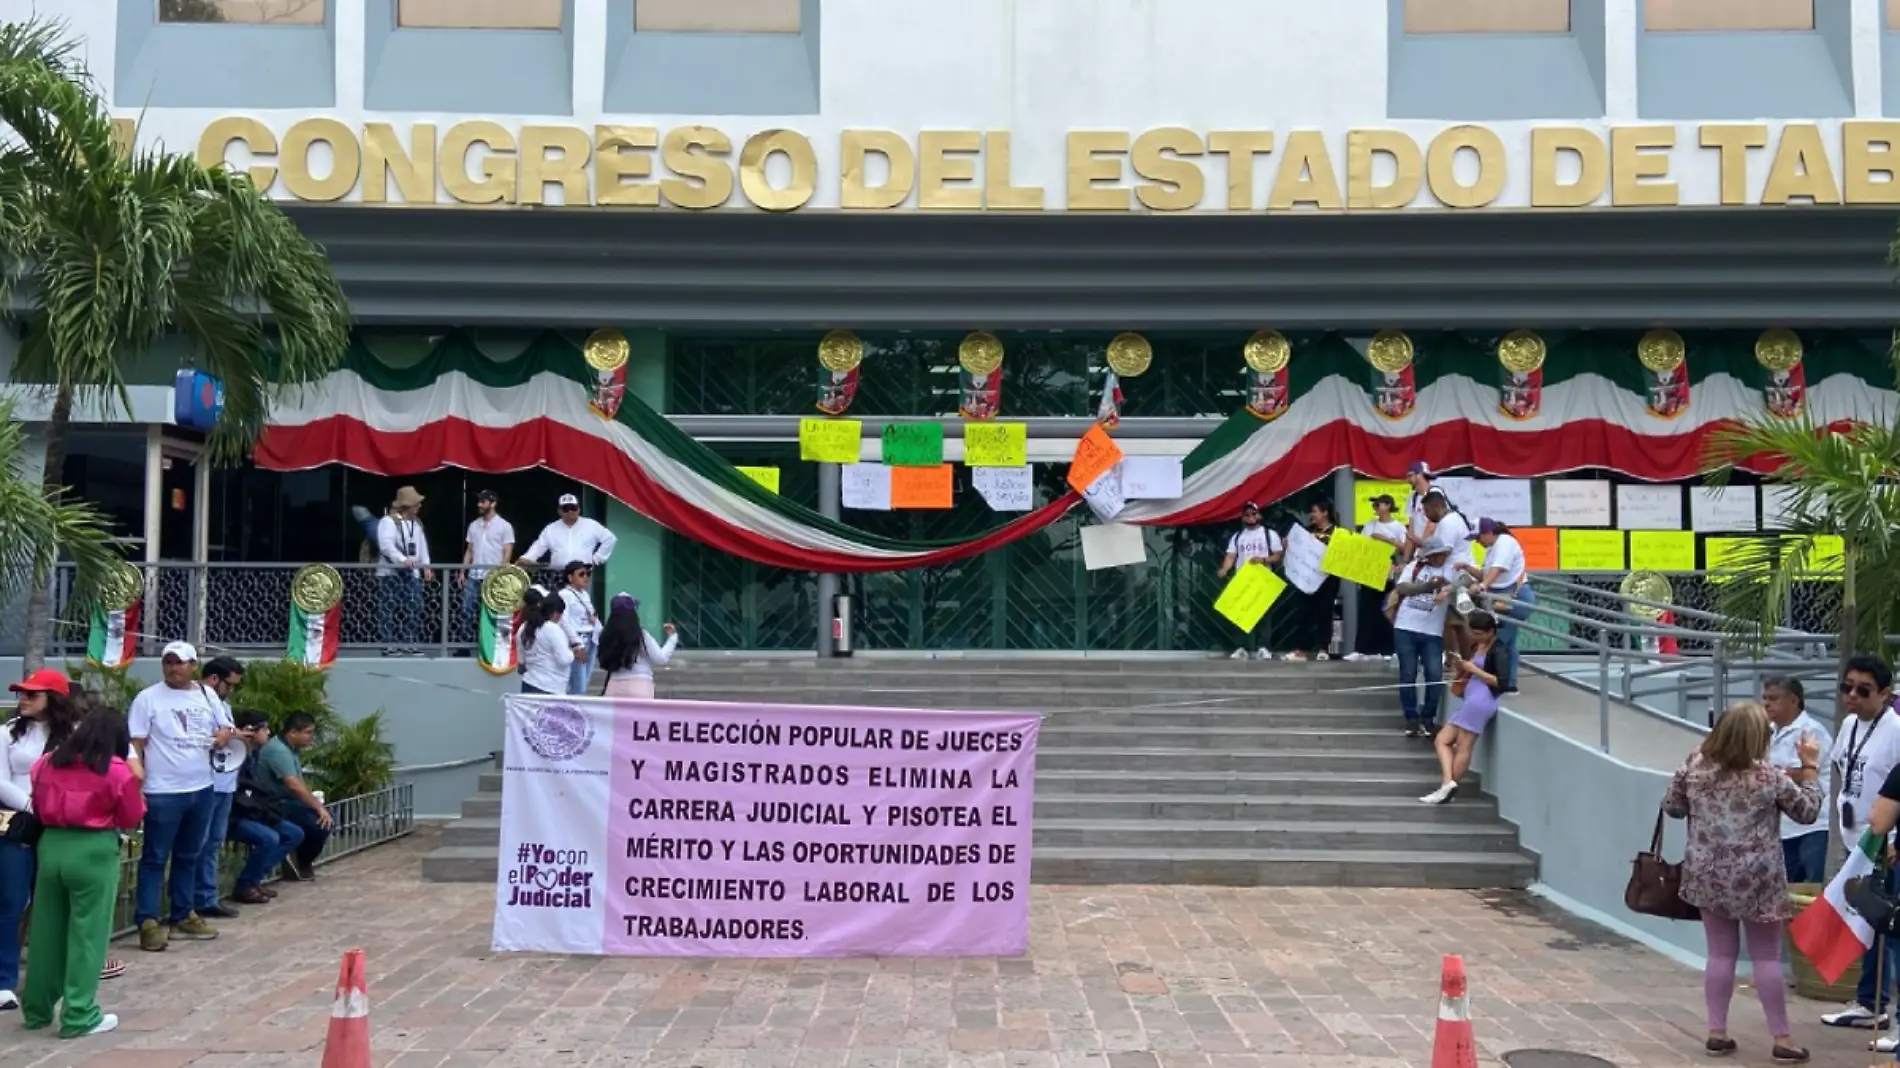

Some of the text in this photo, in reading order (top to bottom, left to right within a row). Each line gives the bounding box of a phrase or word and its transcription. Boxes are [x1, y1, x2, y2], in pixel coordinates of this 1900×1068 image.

[196, 118, 815, 211] CONGRESO
[840, 130, 1043, 211] DEL
[1066, 126, 1505, 212] ESTADO
[1530, 126, 1677, 207] DE
[1700, 123, 1900, 206] TAB
[633, 719, 1022, 752] LA ELECCIÓN POPULAR DE JUECES
[631, 759, 1018, 789] Y MAGISTRADOS ELIMINA LA
[629, 798, 1017, 826] CARRERA JUDICIAL Y PISOTEA EL
[627, 833, 1015, 865] MÉRITO Y LAS OPORTUNIDADES DE
[506, 886, 592, 908] Judicial
[625, 876, 1014, 903] CRECIMIENTO LABORAL DE LOS
[624, 916, 808, 940] TRABAJADORES.
